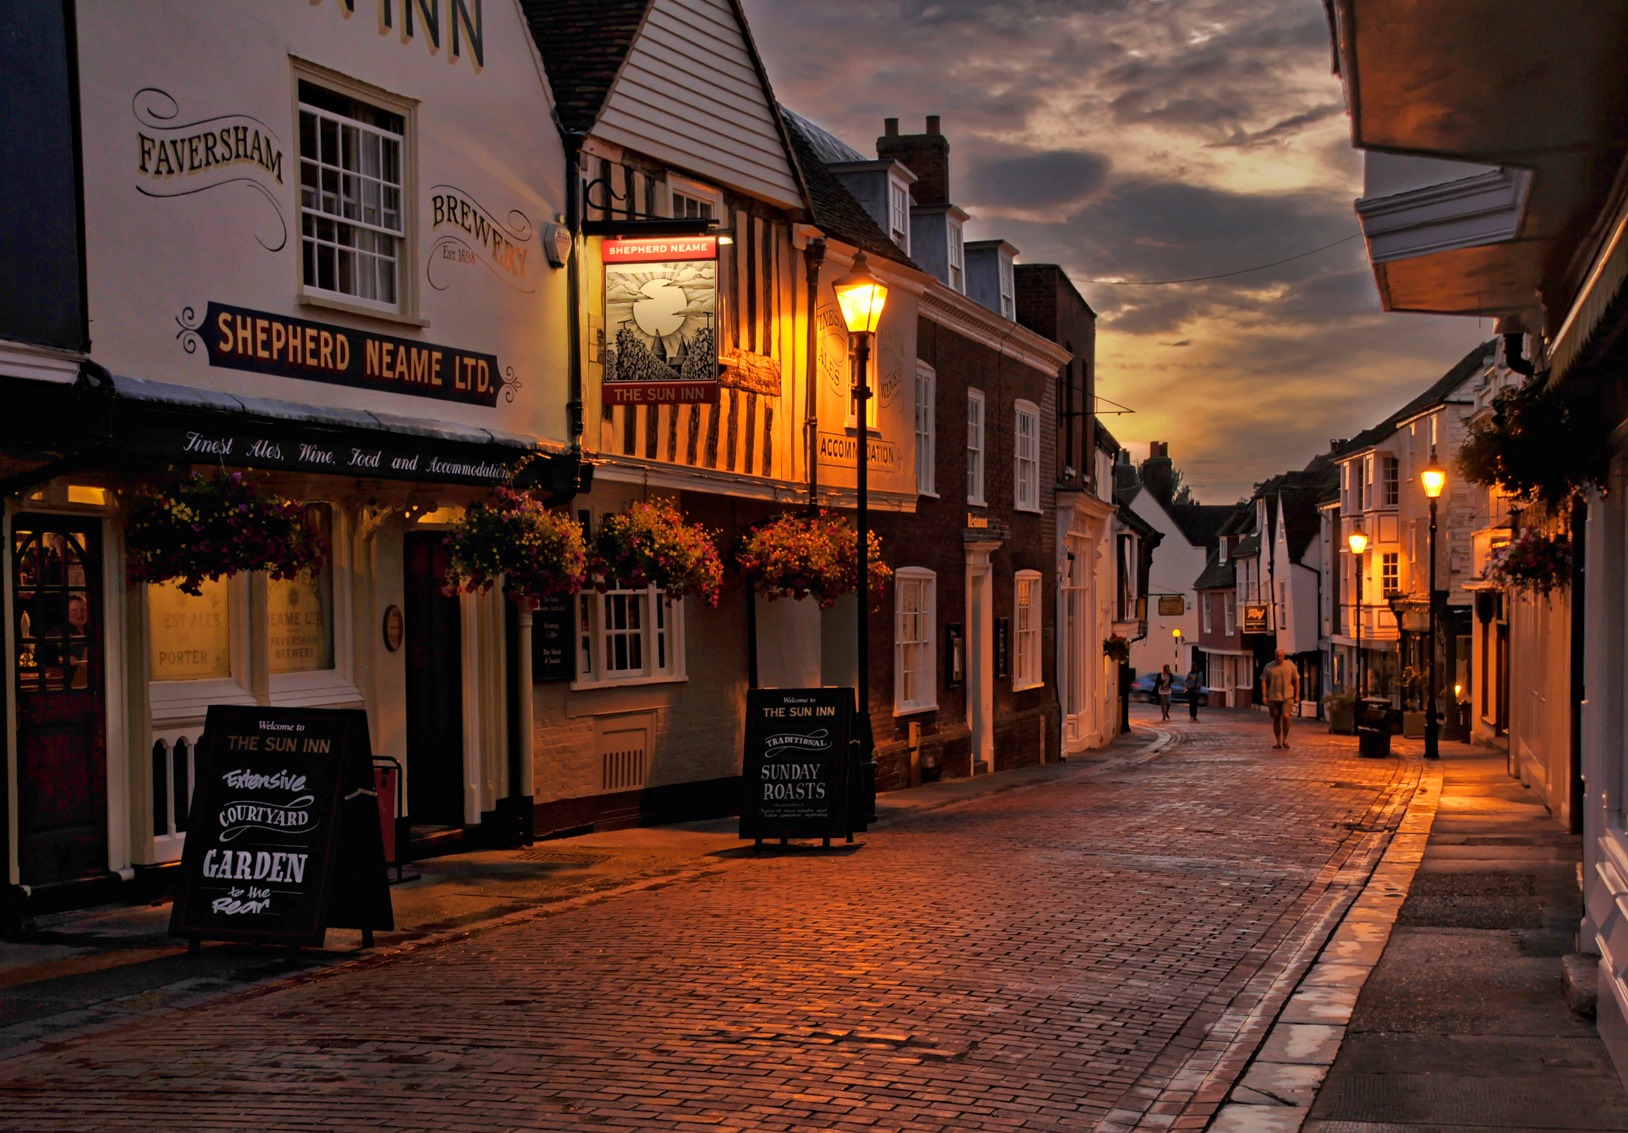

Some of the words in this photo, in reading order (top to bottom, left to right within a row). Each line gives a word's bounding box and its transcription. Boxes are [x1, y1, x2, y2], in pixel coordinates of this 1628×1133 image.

[136, 126, 284, 185] FAVERSHAM
[432, 194, 528, 278] BREWERY
[608, 245, 668, 255] SHEPHERD
[670, 243, 708, 252] NEAME
[218, 312, 350, 371] SHEPHERD
[366, 338, 443, 386] NEAME
[455, 355, 495, 394] LTD.
[818, 346, 840, 387] ALES
[613, 388, 643, 402] THE
[647, 387, 675, 401] SUN
[681, 387, 705, 400] INN
[183, 431, 234, 455] Finest
[246, 439, 285, 462] Ales,
[347, 447, 382, 468] Food
[391, 454, 420, 472] and
[820, 438, 895, 465] ACCOMMDATION
[159, 650, 208, 666] PORTER
[783, 696, 809, 704] Welcome
[763, 707, 786, 718] THE
[789, 707, 812, 717] SUN
[816, 706, 835, 716] INN
[258, 720, 295, 731] Welcome
[296, 723, 305, 732] to
[227, 735, 260, 751] THE
[264, 737, 298, 753] SUN
[303, 738, 332, 754] INN
[765, 736, 827, 747] TRADITIONAL
[222, 768, 308, 792] Extensive
[761, 763, 822, 780] SUNDAY
[763, 782, 827, 800] ROASTS
[218, 804, 309, 828] COURTYARD
[202, 848, 309, 884] GARDEN
[228, 886, 245, 898] to
[247, 885, 272, 899] the
[211, 897, 271, 916] Rear
